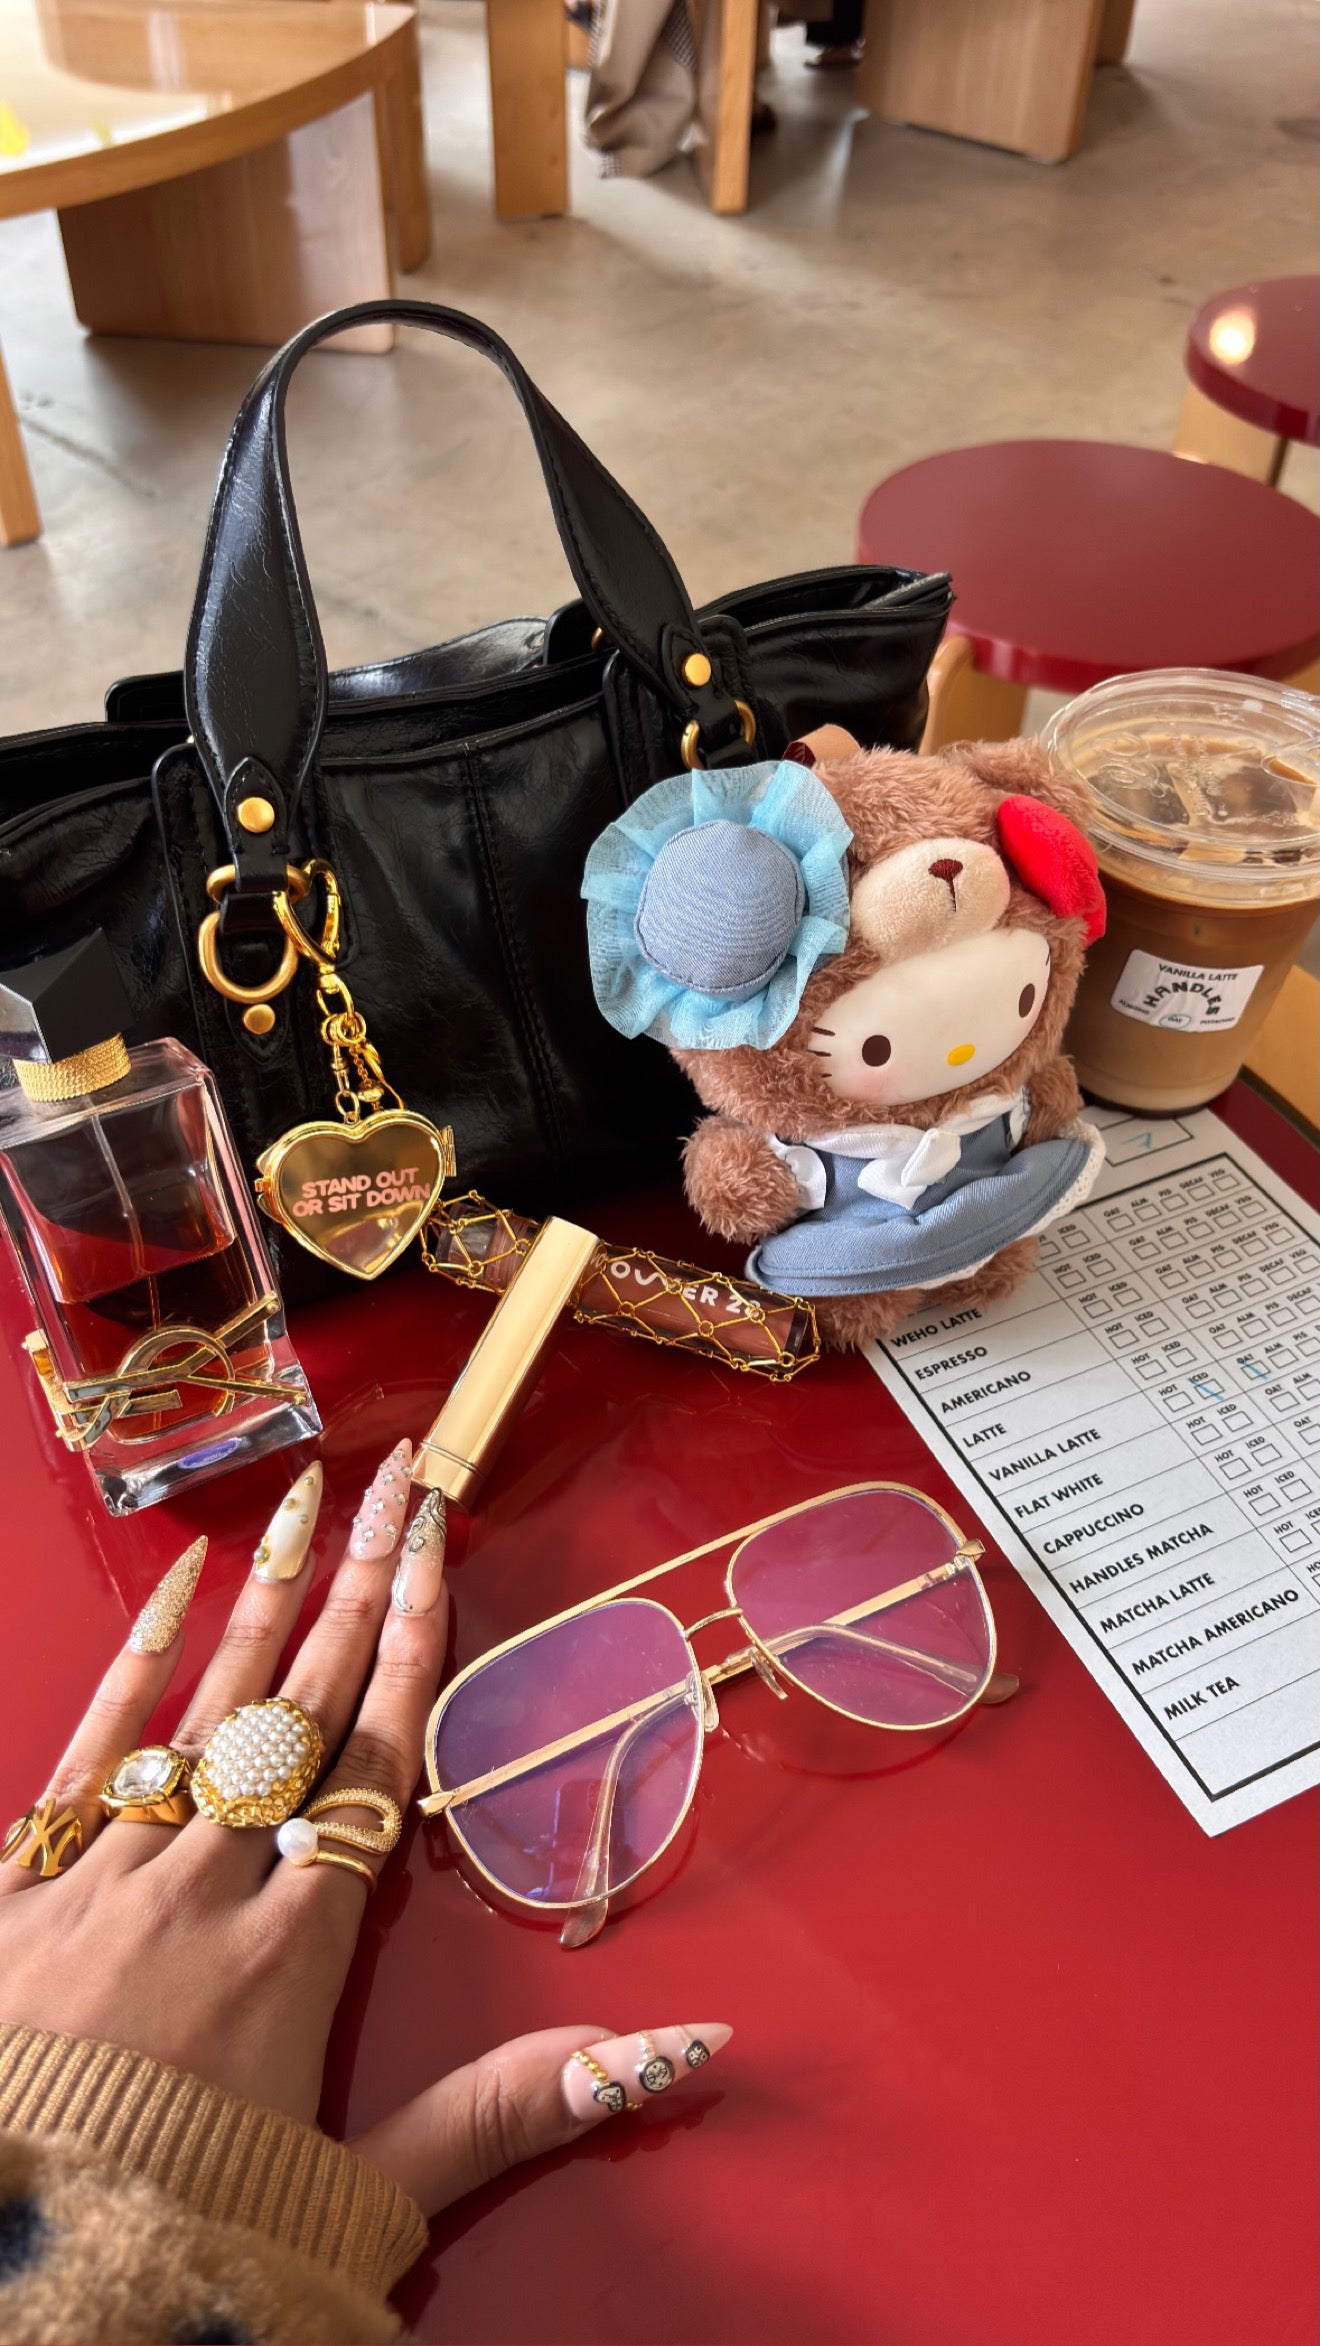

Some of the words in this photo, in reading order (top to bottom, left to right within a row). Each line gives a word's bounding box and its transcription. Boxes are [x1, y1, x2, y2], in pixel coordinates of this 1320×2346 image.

[1158, 963, 1205, 980] VANILLA
[1208, 973, 1238, 981] LATTE
[1143, 981, 1222, 1015] HANDLES
[301, 1175, 372, 1199] STAND
[375, 1167, 420, 1189] OUT
[292, 1199, 323, 1217] OR
[328, 1193, 361, 1212] SIT
[366, 1183, 431, 1207] DOWN
[1156, 1226, 1174, 1237] ALM
[1182, 1254, 1201, 1265] ALM
[1210, 1244, 1225, 1253] PIS
[1232, 1231, 1257, 1244] DECAF
[1052, 1263, 1071, 1275] HOT
[1181, 1293, 1199, 1304] OAT
[1209, 1283, 1228, 1294] ALM
[1237, 1273, 1252, 1282] PIS
[1259, 1258, 1284, 1273] DECAF
[1290, 1249, 1307, 1259] VEG
[1078, 1292, 1098, 1304] HOT
[1208, 1323, 1226, 1334] OAT
[1236, 1311, 1256, 1323] ALM
[1265, 1302, 1280, 1311] PIS
[1286, 1287, 1312, 1302] DECAF
[890, 1324, 938, 1348] WEHO
[940, 1308, 983, 1330] LATTE
[1104, 1322, 1124, 1334] HOT
[1134, 1311, 1154, 1322] ICED
[1131, 1353, 1150, 1365] HOT
[1161, 1341, 1181, 1353] ICED
[1264, 1342, 1284, 1354] ALM
[1292, 1331, 1308, 1341] PIS
[914, 1346, 988, 1380] ESPRESSO
[941, 1370, 1031, 1414] AMERICANO
[1158, 1384, 1179, 1397] HOT
[1189, 1372, 1209, 1384] ICED
[1264, 1384, 1282, 1396] OAT
[1292, 1372, 1312, 1384] ALM
[1186, 1416, 1207, 1429] HOT
[1217, 1403, 1237, 1416] ICED
[1293, 1416, 1312, 1428] OAT
[962, 1423, 1007, 1448] LATTE
[1214, 1450, 1235, 1463] HOT
[1245, 1436, 1265, 1449] ICED
[988, 1447, 1057, 1481] VANILLA
[1055, 1428, 1101, 1452] LATTE
[1014, 1495, 1052, 1519] FLAT
[1051, 1473, 1104, 1502] WHITE
[1243, 1485, 1264, 1498] HOT
[1274, 1470, 1295, 1484] ICED
[1042, 1503, 1145, 1555] CAPPUCCINO
[1273, 1520, 1294, 1534] HOT
[1305, 1506, 1320, 1520] ICE
[1068, 1552, 1145, 1594] HANDLES
[1144, 1523, 1214, 1561] MATCHA
[1306, 1561, 1320, 1574] HO
[1099, 1594, 1170, 1634] MATCHA
[1170, 1572, 1215, 1597] LATTE
[1131, 1635, 1202, 1676] MATCHA
[1202, 1588, 1299, 1643] AMERICANO
[1163, 1691, 1208, 1721] MILK
[1205, 1675, 1240, 1698] TEA
